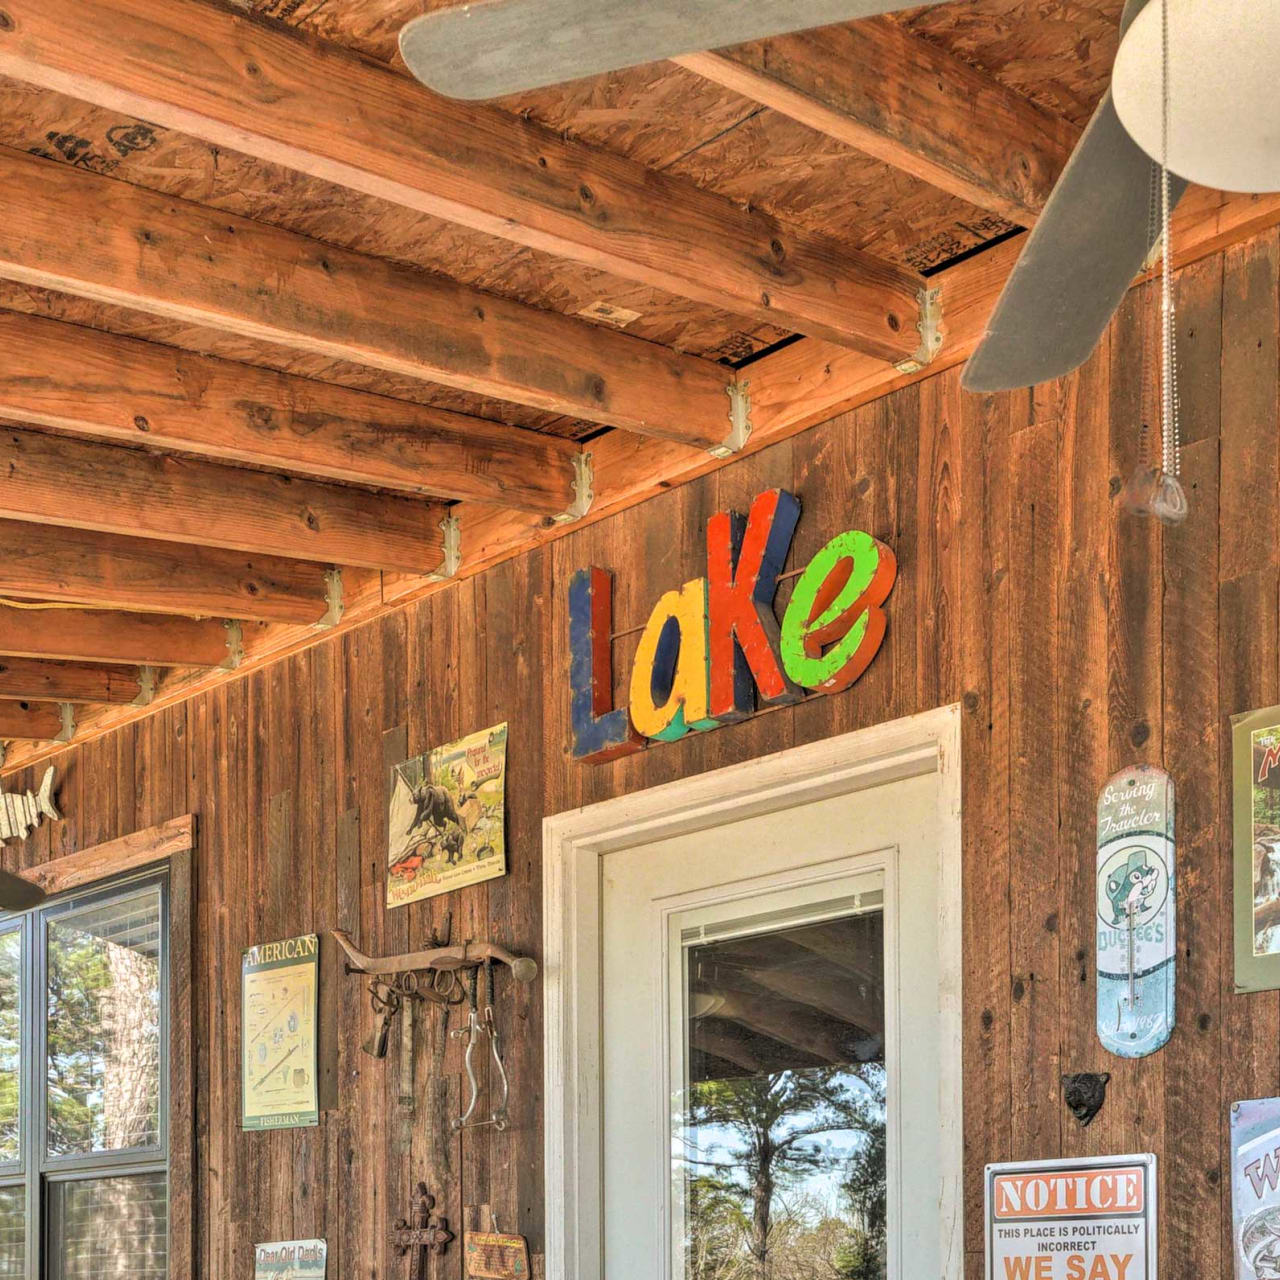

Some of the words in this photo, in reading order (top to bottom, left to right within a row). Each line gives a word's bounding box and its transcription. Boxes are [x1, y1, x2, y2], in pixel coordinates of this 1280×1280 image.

[1103, 781, 1156, 805] Serving
[1119, 802, 1137, 817] the
[1100, 810, 1161, 836] Traveler
[1097, 922, 1165, 952] BUCEE'S
[244, 937, 316, 968] AMERICAN
[259, 1113, 300, 1127] FISHERMAN
[999, 1174, 1138, 1212] NOTICE
[997, 1228, 1021, 1239] THIS
[1023, 1227, 1056, 1238] PLACE
[1059, 1226, 1069, 1237] IS
[1072, 1224, 1140, 1237] POLITICALLY
[258, 1247, 279, 1263] Dear
[280, 1245, 296, 1262] Old
[297, 1244, 324, 1261] Dad's
[1037, 1240, 1097, 1252] INCORRECT
